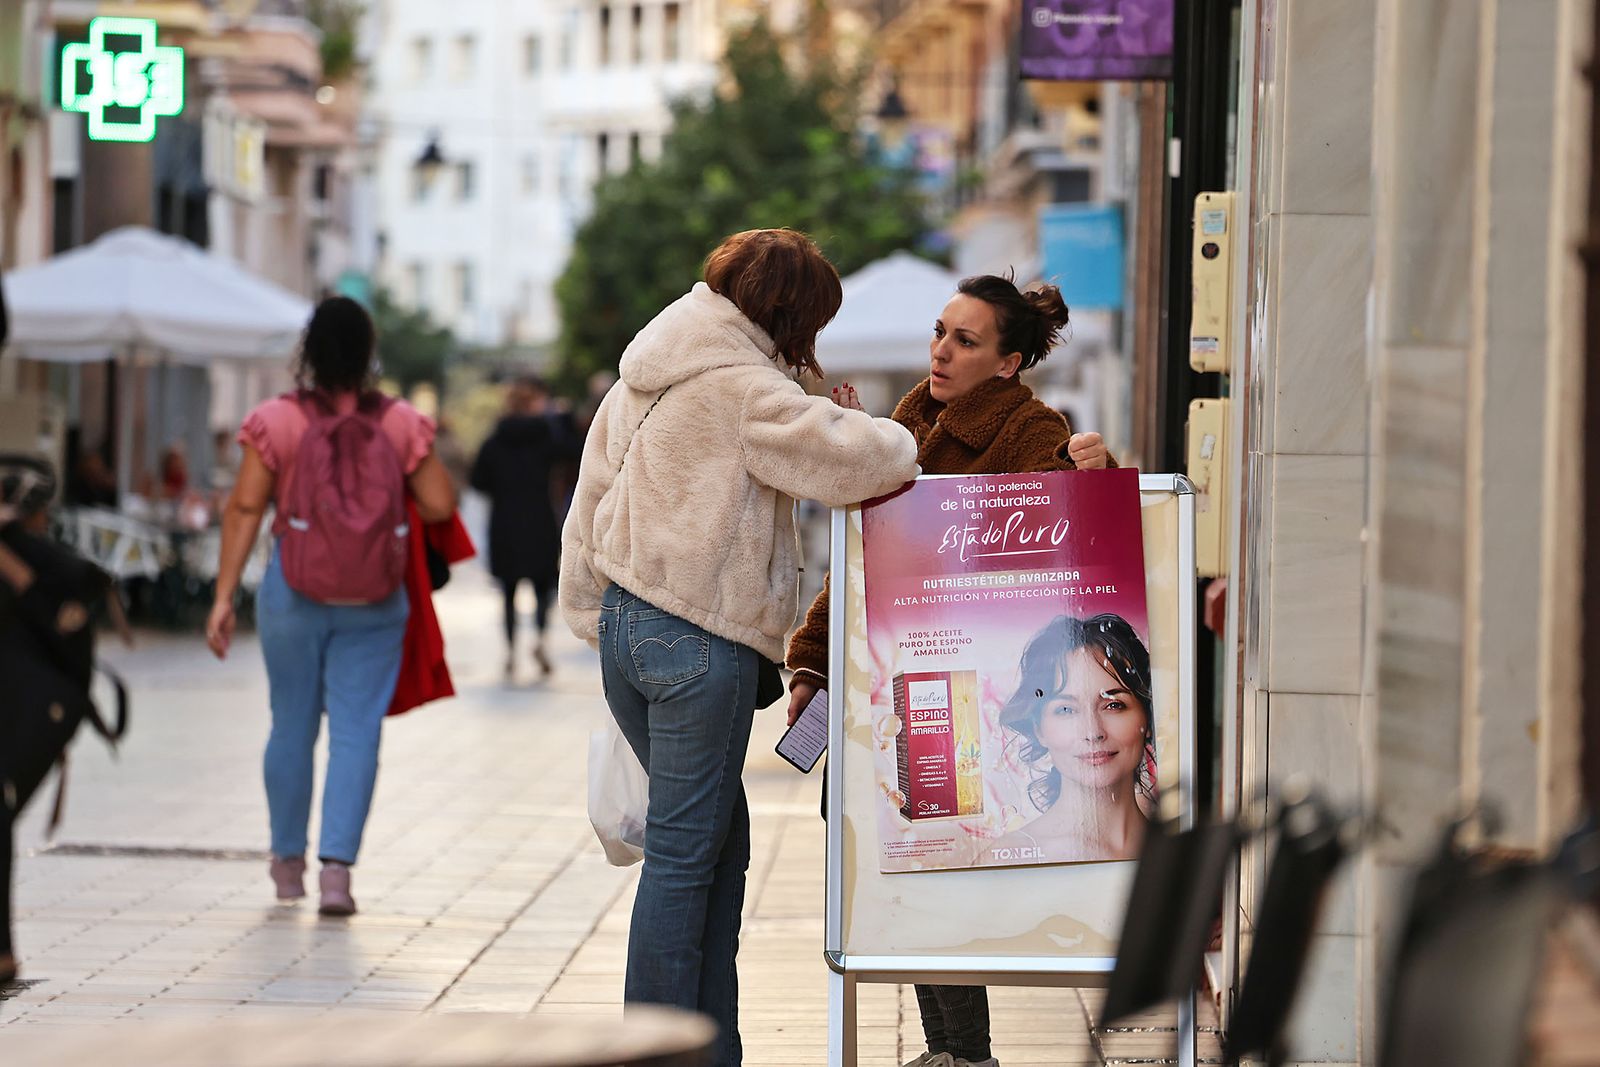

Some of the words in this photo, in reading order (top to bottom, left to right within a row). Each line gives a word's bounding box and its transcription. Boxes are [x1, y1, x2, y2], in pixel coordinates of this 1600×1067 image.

[956, 483, 983, 494] Toda
[985, 483, 995, 492] la
[998, 480, 1043, 494] potencia
[940, 499, 958, 511] de
[962, 497, 975, 510] la
[979, 494, 1051, 509] naturaleza
[970, 512, 983, 520] en
[923, 574, 1015, 589] NUTRIESTÉTICA
[1019, 570, 1080, 583] AVANZADA
[893, 597, 919, 606] ALTA
[921, 591, 980, 604] NUTRICIÓN
[982, 592, 990, 600] Y
[992, 587, 1059, 600] PROTECCIÓN
[1062, 587, 1076, 596] DE
[1079, 586, 1092, 595] LA
[1095, 585, 1118, 594] PIEL
[908, 631, 930, 640] 100%
[932, 629, 963, 638] ACEITE
[899, 640, 924, 649] PURO
[939, 637, 973, 646] ESPINO
[913, 647, 959, 657] AMARILLO
[910, 709, 949, 721] ESPINO
[910, 726, 950, 736] AMARILLO
[929, 803, 939, 811] 30
